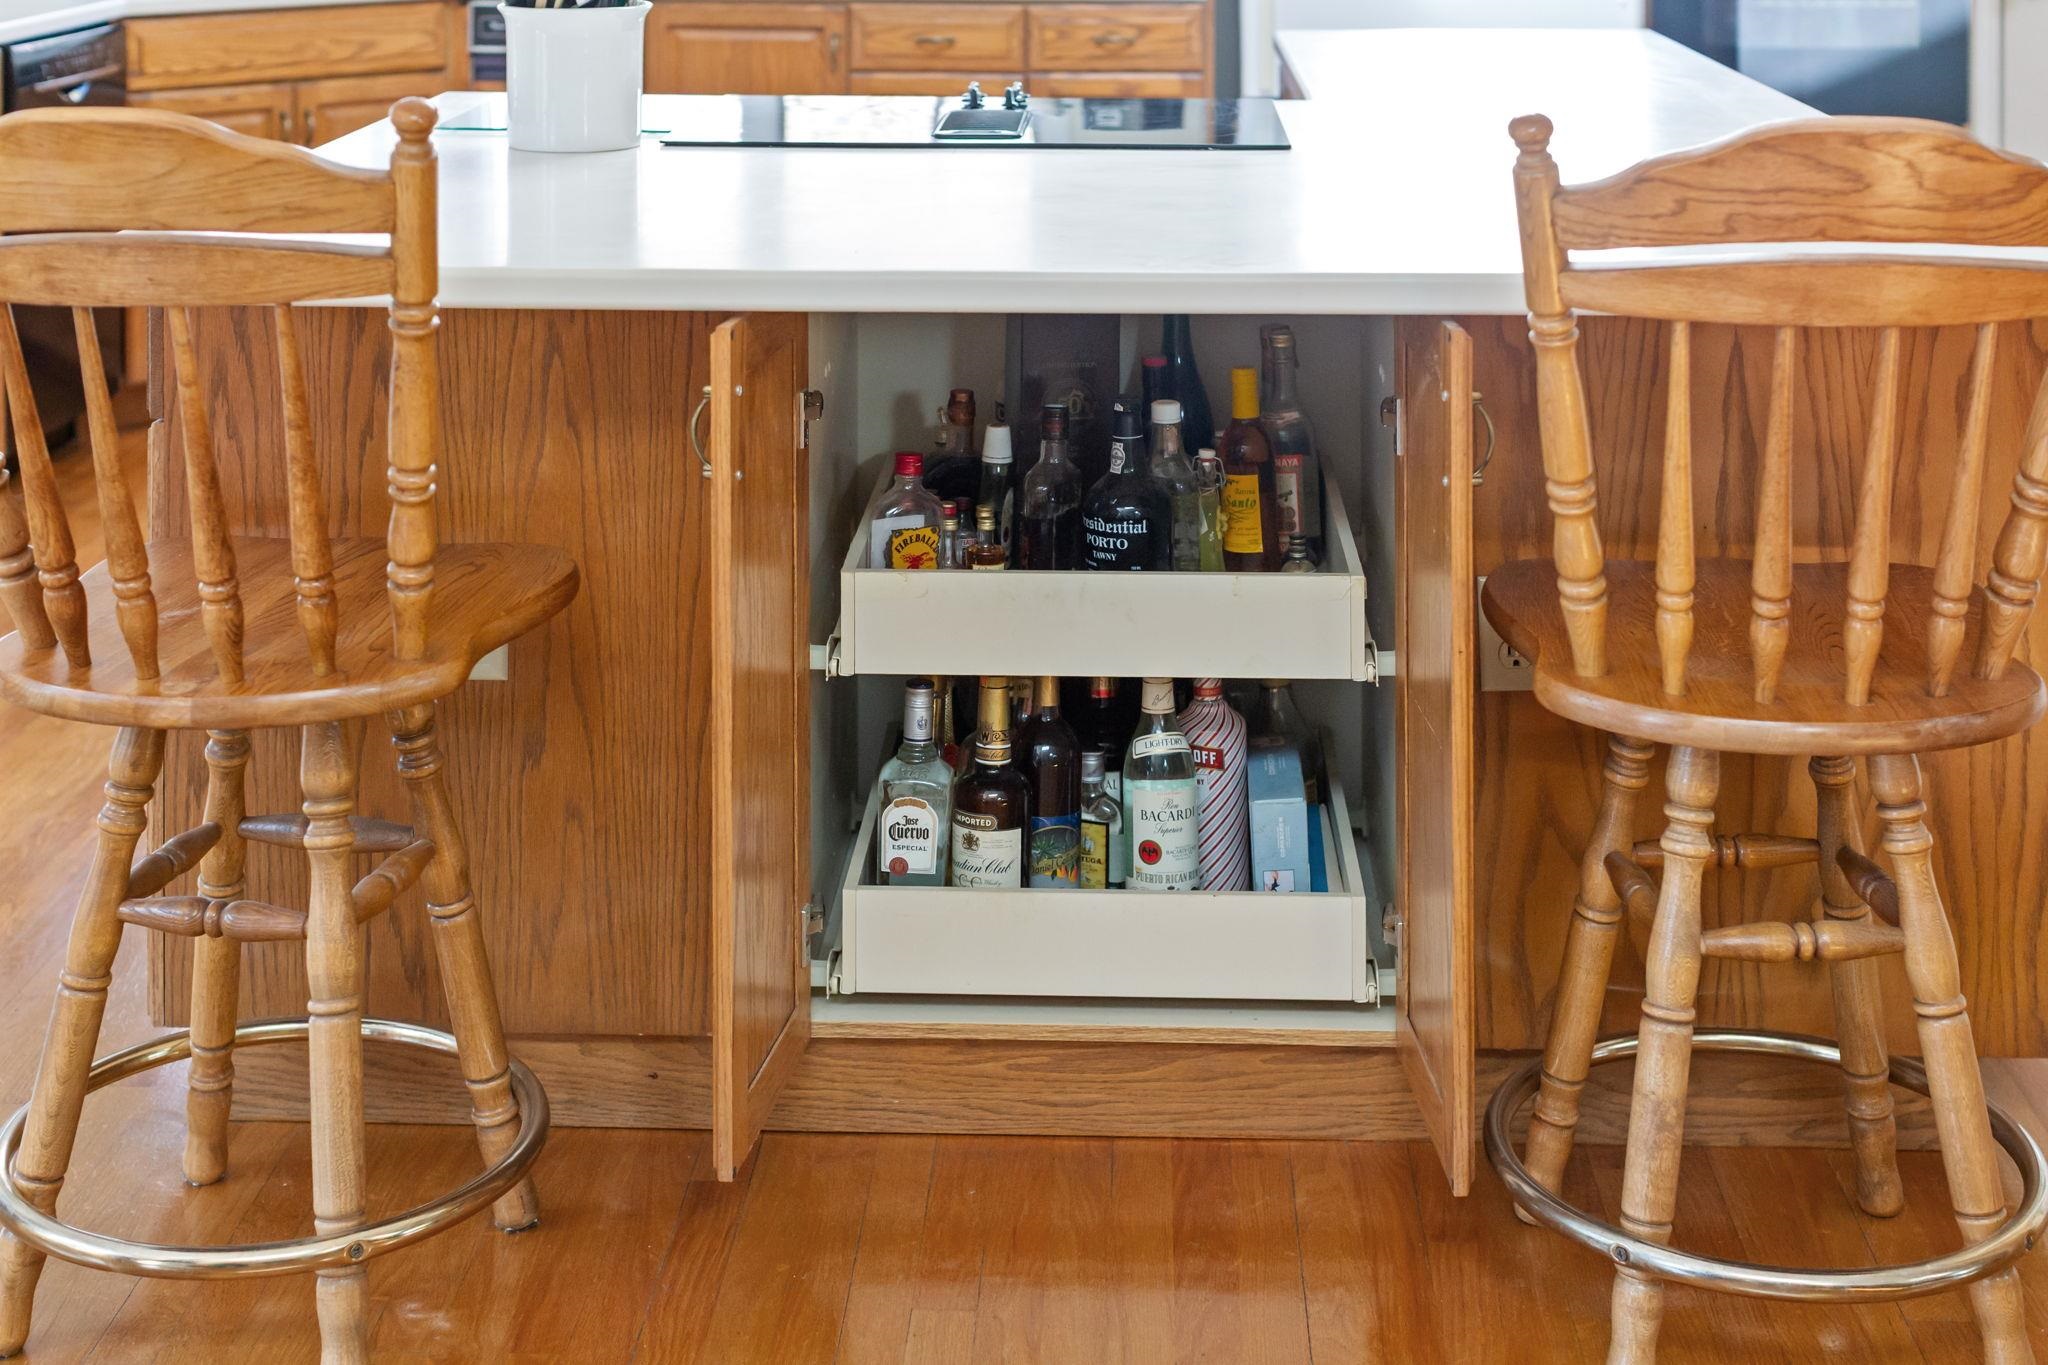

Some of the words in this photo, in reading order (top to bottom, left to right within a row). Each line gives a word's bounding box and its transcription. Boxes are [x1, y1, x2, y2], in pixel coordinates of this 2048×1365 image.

[1082, 516, 1148, 534] residential
[895, 533, 938, 553] FIREBALL
[1086, 532, 1129, 550] PORTO
[1093, 550, 1117, 561] TAWNY
[902, 815, 919, 827] Jose
[957, 814, 992, 827] MPORTED
[1140, 806, 1195, 823] BACARDI
[888, 822, 930, 841] Cuervo
[892, 844, 928, 852] ESPECIAL
[1136, 872, 1163, 884] PUERTO
